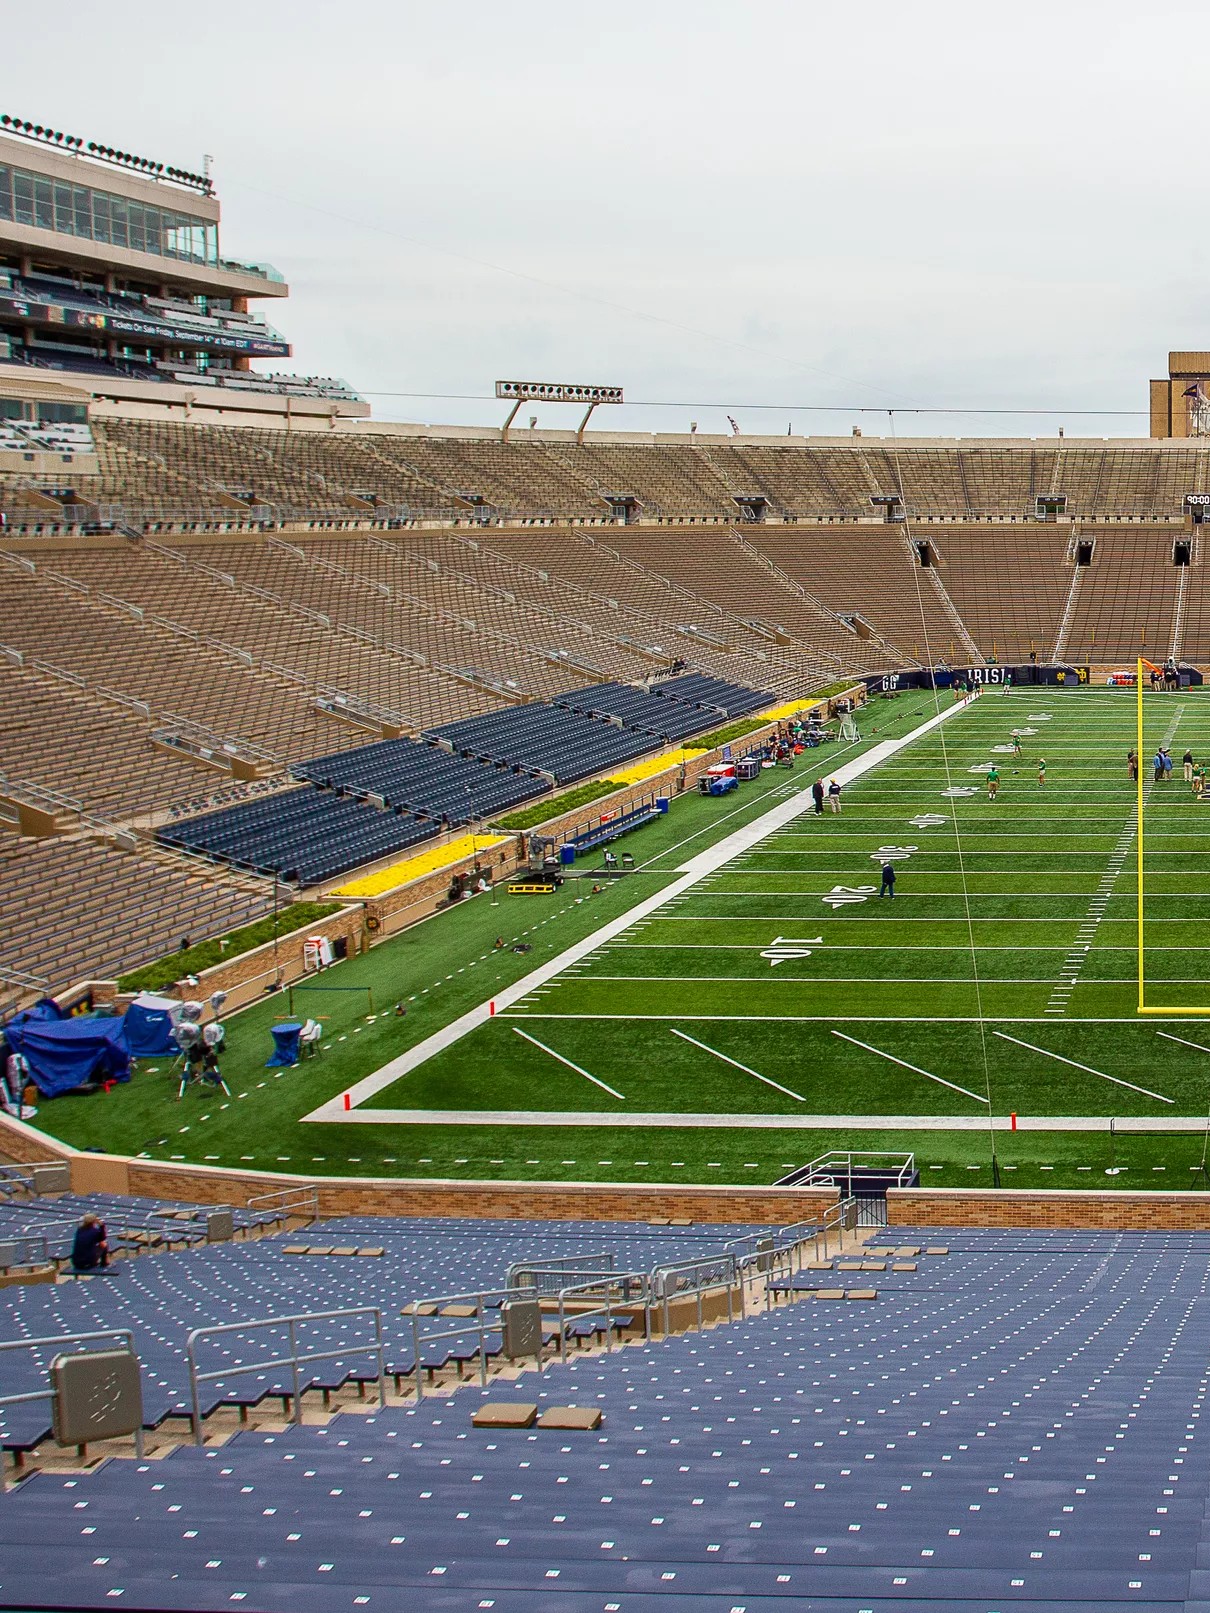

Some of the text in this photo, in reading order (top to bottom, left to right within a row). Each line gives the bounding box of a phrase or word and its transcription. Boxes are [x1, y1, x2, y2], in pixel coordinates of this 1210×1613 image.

[869, 844, 919, 860] 30
[821, 885, 878, 904] 20
[760, 936, 824, 959] 10
